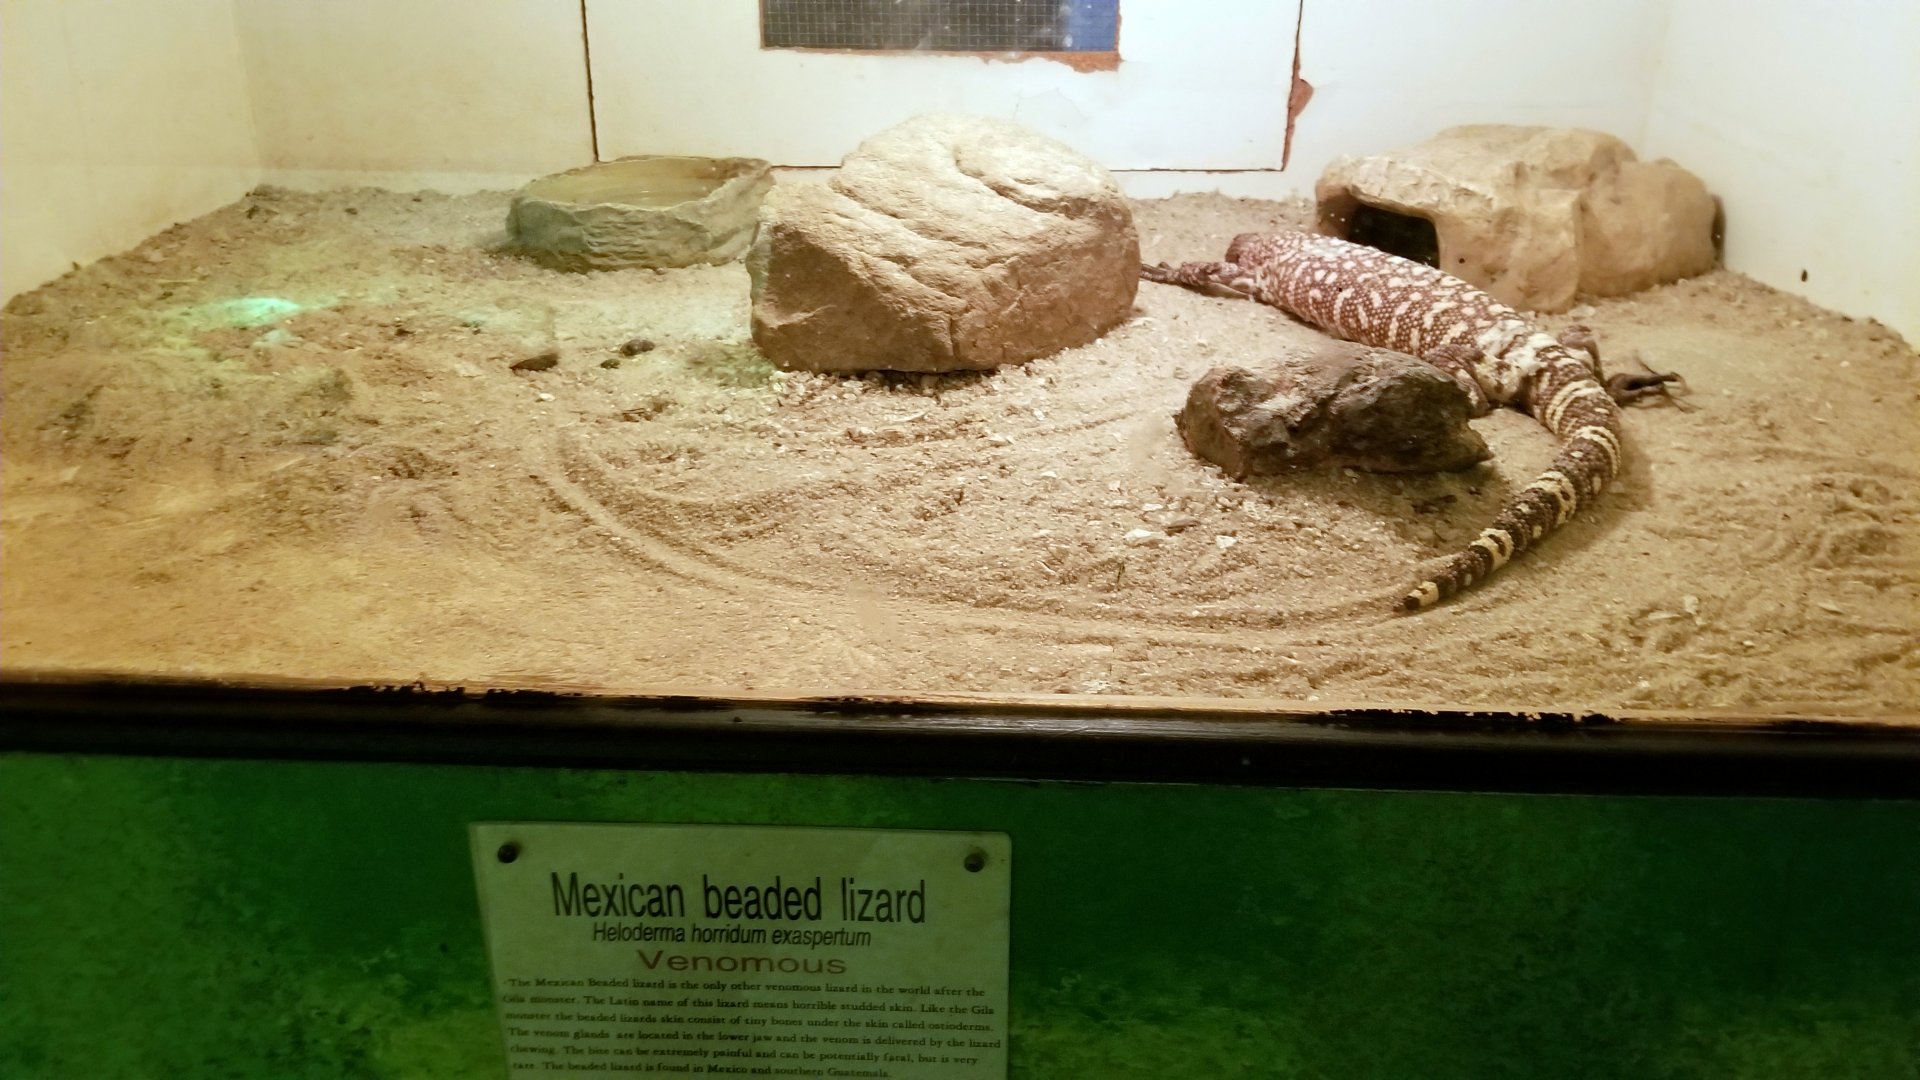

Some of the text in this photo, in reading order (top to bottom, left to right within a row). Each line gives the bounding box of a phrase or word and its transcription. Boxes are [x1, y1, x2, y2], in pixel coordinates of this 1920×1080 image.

[550, 871, 926, 923] Mexican beaded lizard
[592, 922, 872, 950] Heloderma horridum exaspertum
[636, 949, 847, 975] Venomous
[507, 978, 985, 997] The Mexican Beaded lizard is the only other venomous lizard in the world after the
[583, 995, 606, 1005] The
[609, 996, 639, 1006] Latin
[642, 998, 673, 1007] name
[676, 997, 689, 1008] of
[692, 998, 714, 1008] this
[716, 998, 749, 1008] lizard
[752, 1000, 789, 1009] means
[792, 1000, 837, 1011] horrible
[840, 1001, 886, 1012] studded
[920, 1003, 945, 1014] Like
[949, 1004, 968, 1015] the
[505, 1012, 551, 1020] monster
[555, 1011, 574, 1021] the
[577, 1012, 616, 1023] beaded
[620, 1013, 658, 1023] lizards
[660, 1013, 684, 1024] skin
[687, 1014, 726, 1024] consist
[729, 1015, 742, 1025] of
[743, 1016, 767, 1028] tiny
[771, 1016, 803, 1026] bones
[807, 1017, 840, 1027] under
[843, 1018, 862, 1028] the
[865, 1018, 889, 1029] skin
[892, 1019, 925, 1030] called
[507, 1027, 530, 1037] The
[533, 1030, 570, 1038] venom
[573, 1029, 610, 1041] glands
[638, 1030, 679, 1040] located
[682, 1031, 694, 1041] in
[696, 1031, 715, 1041] the
[718, 1032, 749, 1041] lower
[752, 1033, 773, 1043] jaw
[775, 1033, 796, 1043] and
[800, 1033, 818, 1043] the
[822, 1035, 859, 1044] venom
[862, 1035, 872, 1045] is
[875, 1036, 926, 1047] delivered
[929, 1037, 943, 1048] by
[946, 1037, 965, 1048] the
[969, 1038, 1001, 1049] lizard
[562, 1045, 585, 1055] The
[613, 1047, 633, 1056] can
[636, 1046, 650, 1056] be
[653, 1047, 709, 1058] extremely
[712, 1048, 752, 1059] painful
[755, 1049, 777, 1059] and
[779, 1051, 800, 1059] can
[803, 1050, 815, 1060] be
[819, 1051, 881, 1063] potentially
[918, 1053, 938, 1063] but
[941, 1054, 950, 1064] is
[953, 1056, 978, 1066] very
[541, 1061, 564, 1071] The
[567, 1062, 607, 1071] beaded
[610, 1062, 642, 1072] lizard
[645, 1062, 654, 1072] is
[657, 1062, 690, 1073] found
[693, 1063, 704, 1073] in
[707, 1063, 747, 1074] Mexico
[750, 1065, 772, 1074] and
[775, 1065, 824, 1076] southern
